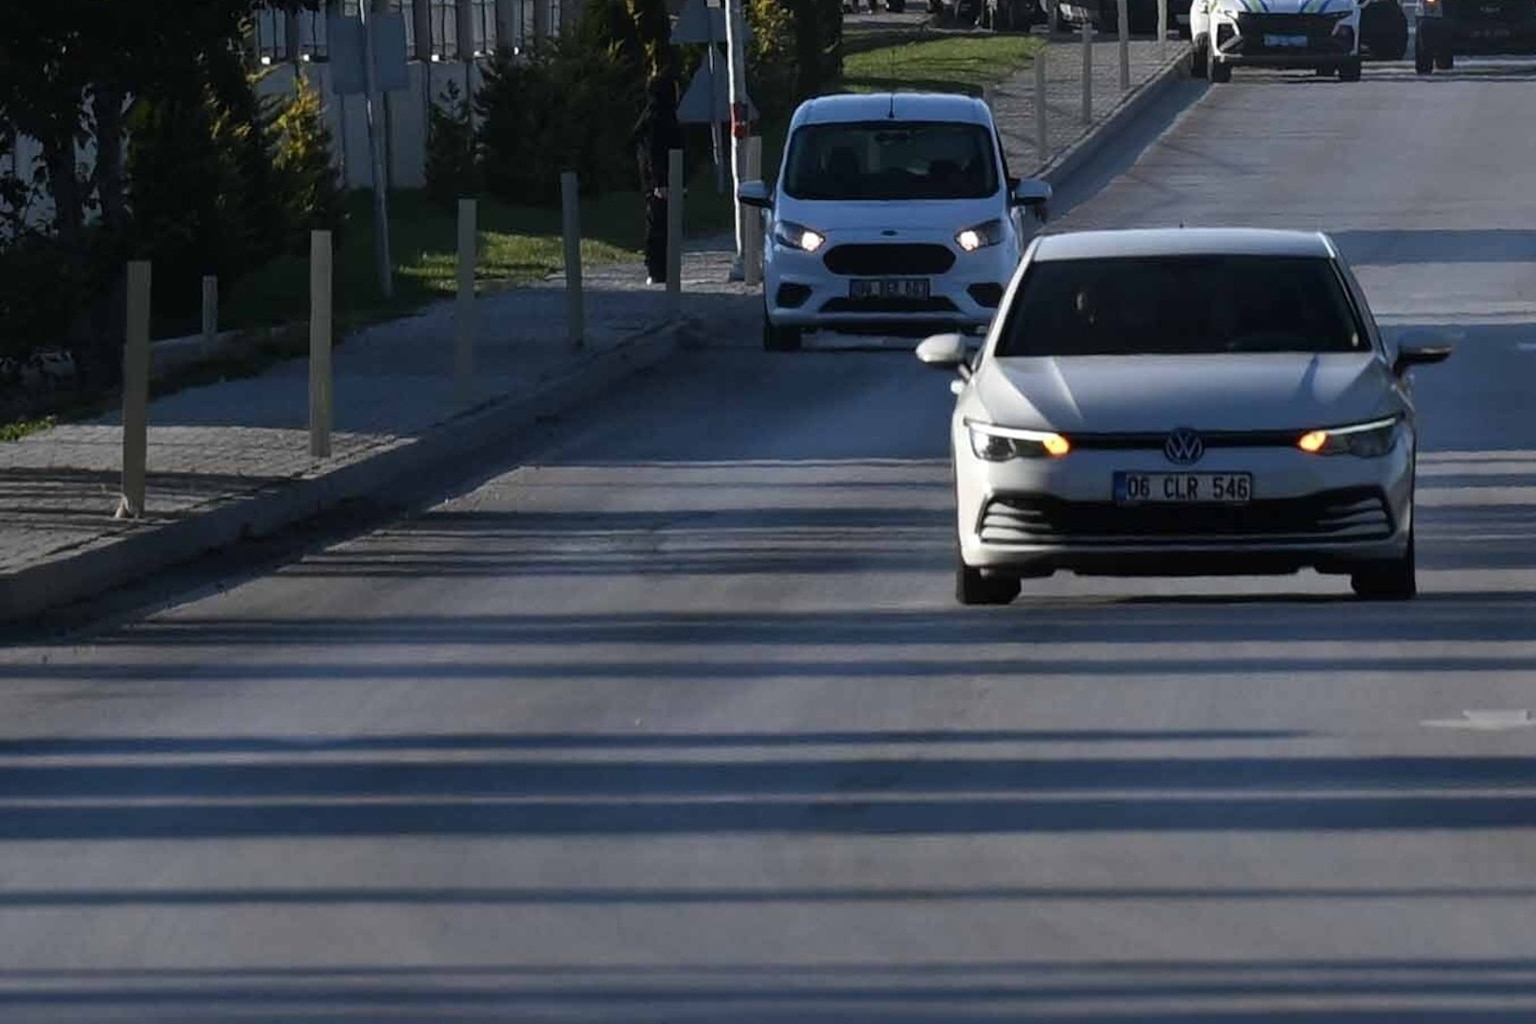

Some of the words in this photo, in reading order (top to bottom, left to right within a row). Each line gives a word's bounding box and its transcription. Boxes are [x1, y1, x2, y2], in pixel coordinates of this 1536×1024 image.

[1127, 477, 1151, 497] 06
[1164, 476, 1198, 498] CLR
[1213, 476, 1248, 498] 546
